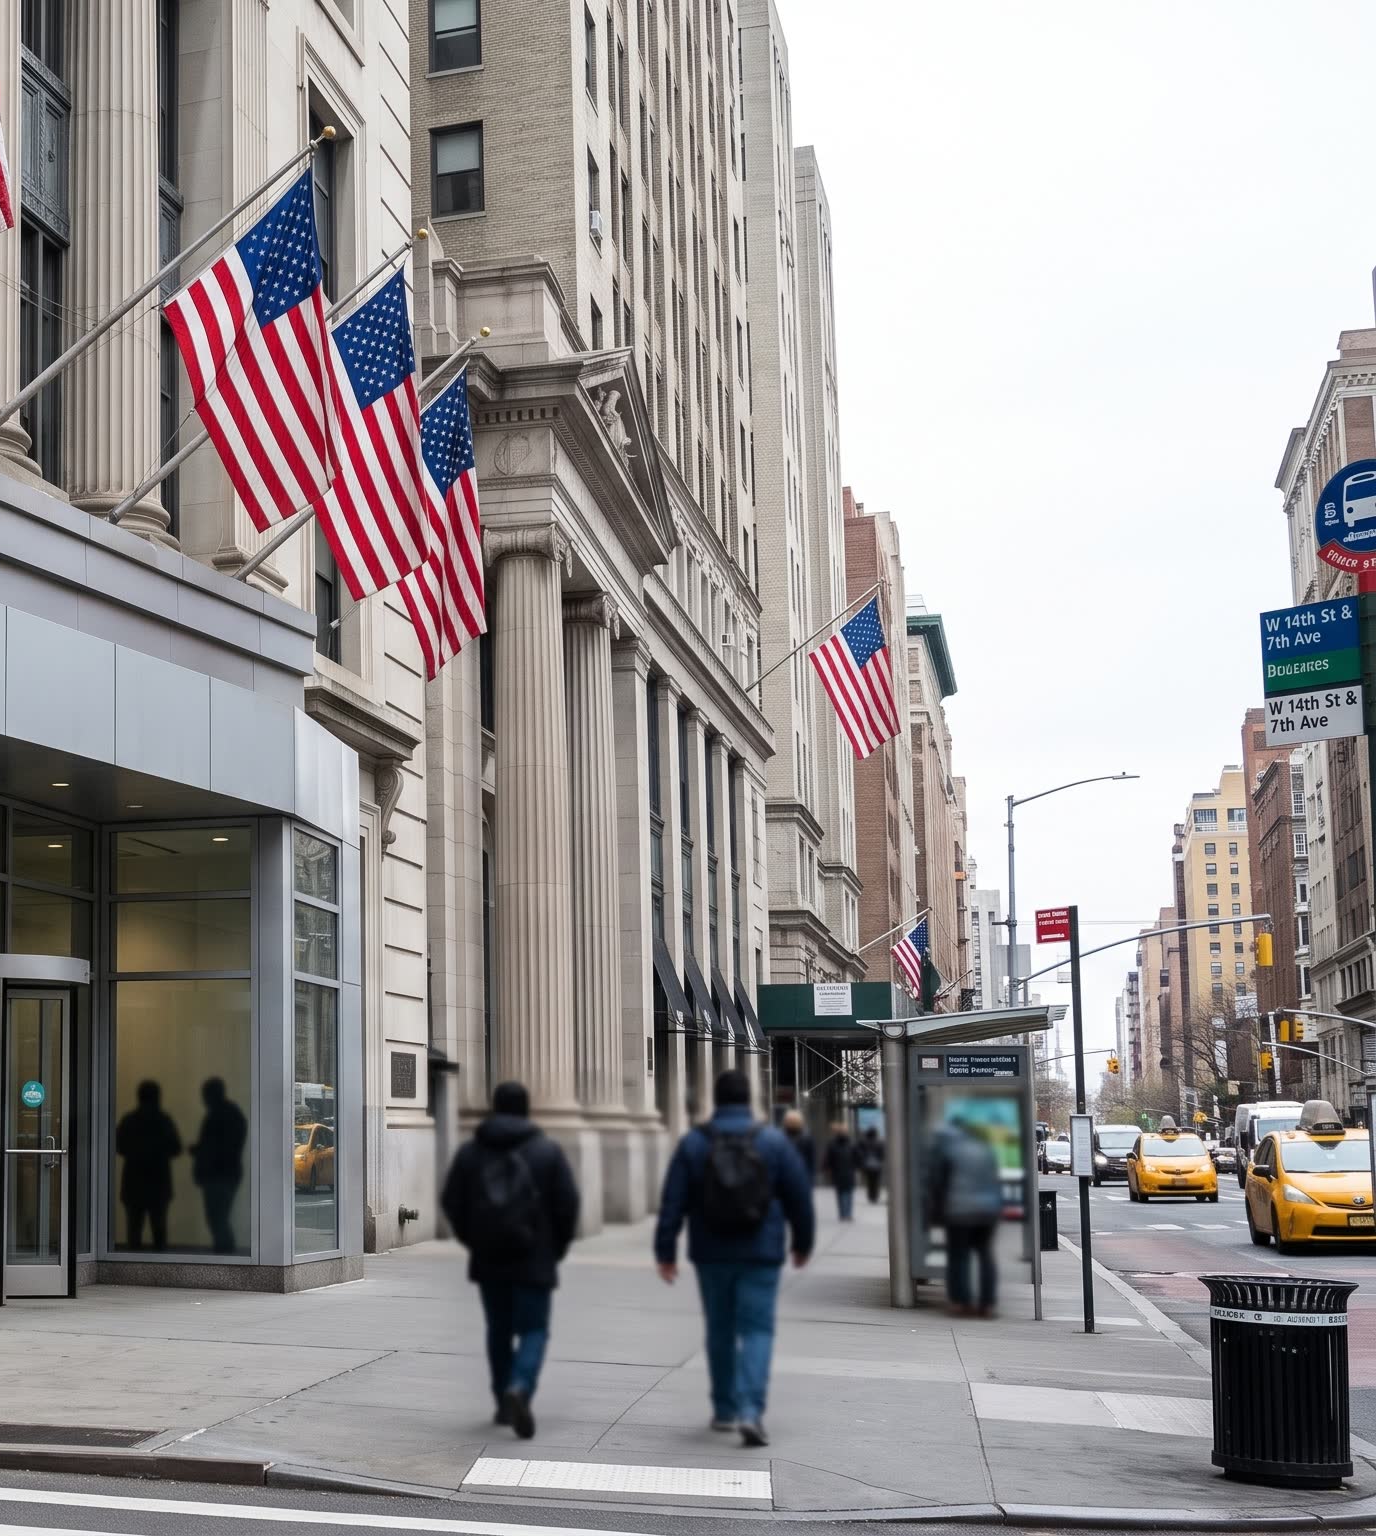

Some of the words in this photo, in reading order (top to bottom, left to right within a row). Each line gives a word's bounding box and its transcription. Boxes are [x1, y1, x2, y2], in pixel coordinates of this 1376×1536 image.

[1265, 617, 1280, 632] W
[1284, 611, 1315, 629] 14th
[1321, 608, 1336, 623] St
[1341, 604, 1352, 620] &
[1266, 634, 1290, 650] 7th
[1294, 631, 1321, 646] Ave
[1269, 700, 1283, 715] W
[1288, 695, 1319, 713] 14th
[1325, 693, 1341, 708] St
[1346, 690, 1357, 705] &
[1270, 717, 1295, 733] 7th
[1300, 715, 1329, 730] Ave
